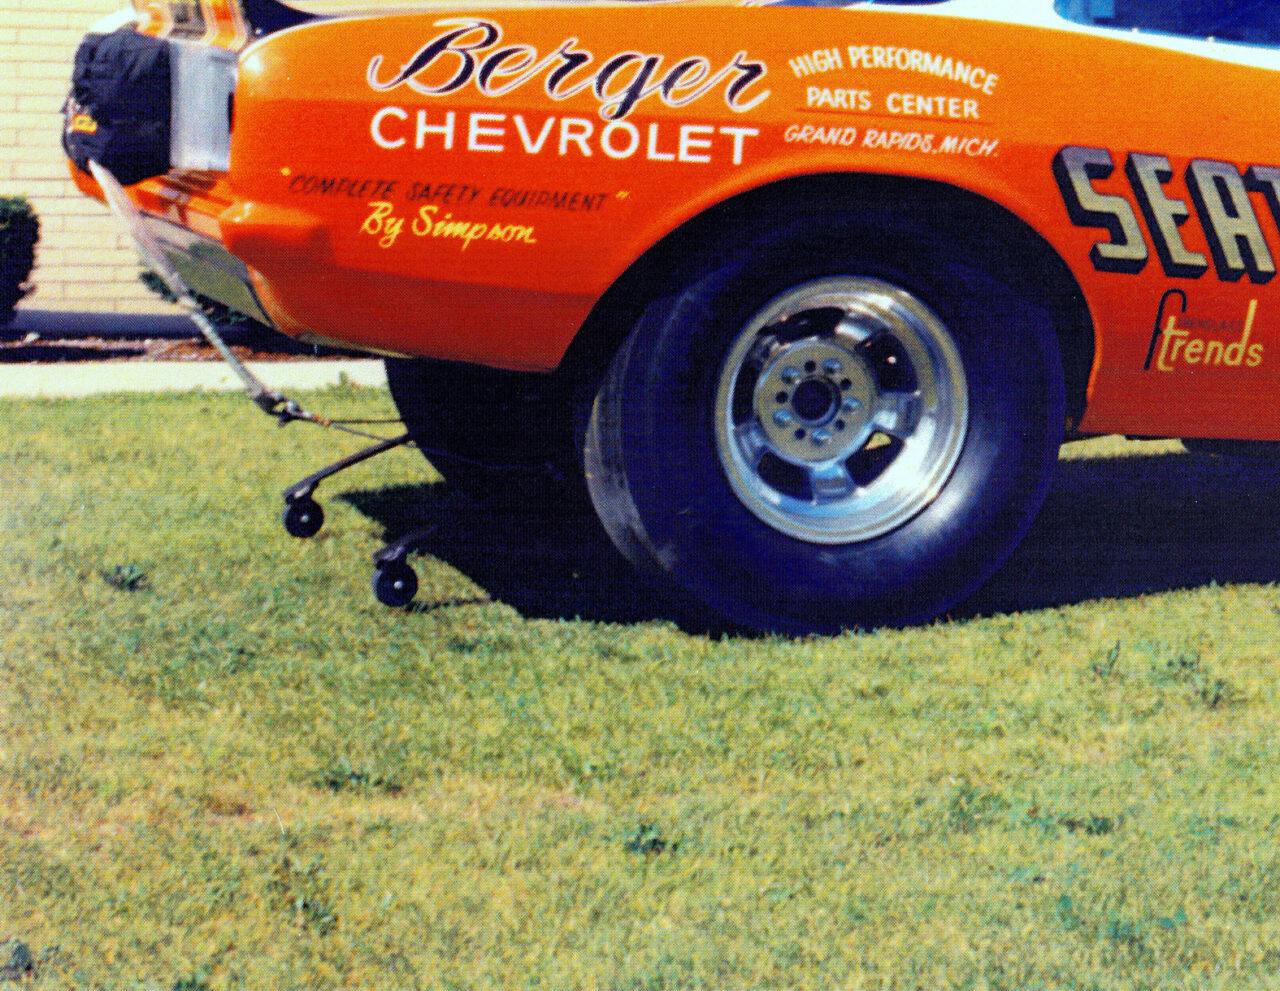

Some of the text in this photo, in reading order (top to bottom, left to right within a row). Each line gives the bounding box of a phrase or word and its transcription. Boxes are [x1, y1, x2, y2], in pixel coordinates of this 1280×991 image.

[368, 18, 771, 120] Berger
[788, 45, 999, 95] HIGH PERFORMANCE
[806, 85, 980, 119] PARTS CENTER
[370, 106, 759, 165] CHEVROLET
[784, 124, 857, 146] GRAND
[289, 174, 608, 211] COMPLETE SAFETY EQUIPMENT
[360, 201, 537, 251] By Simpson
